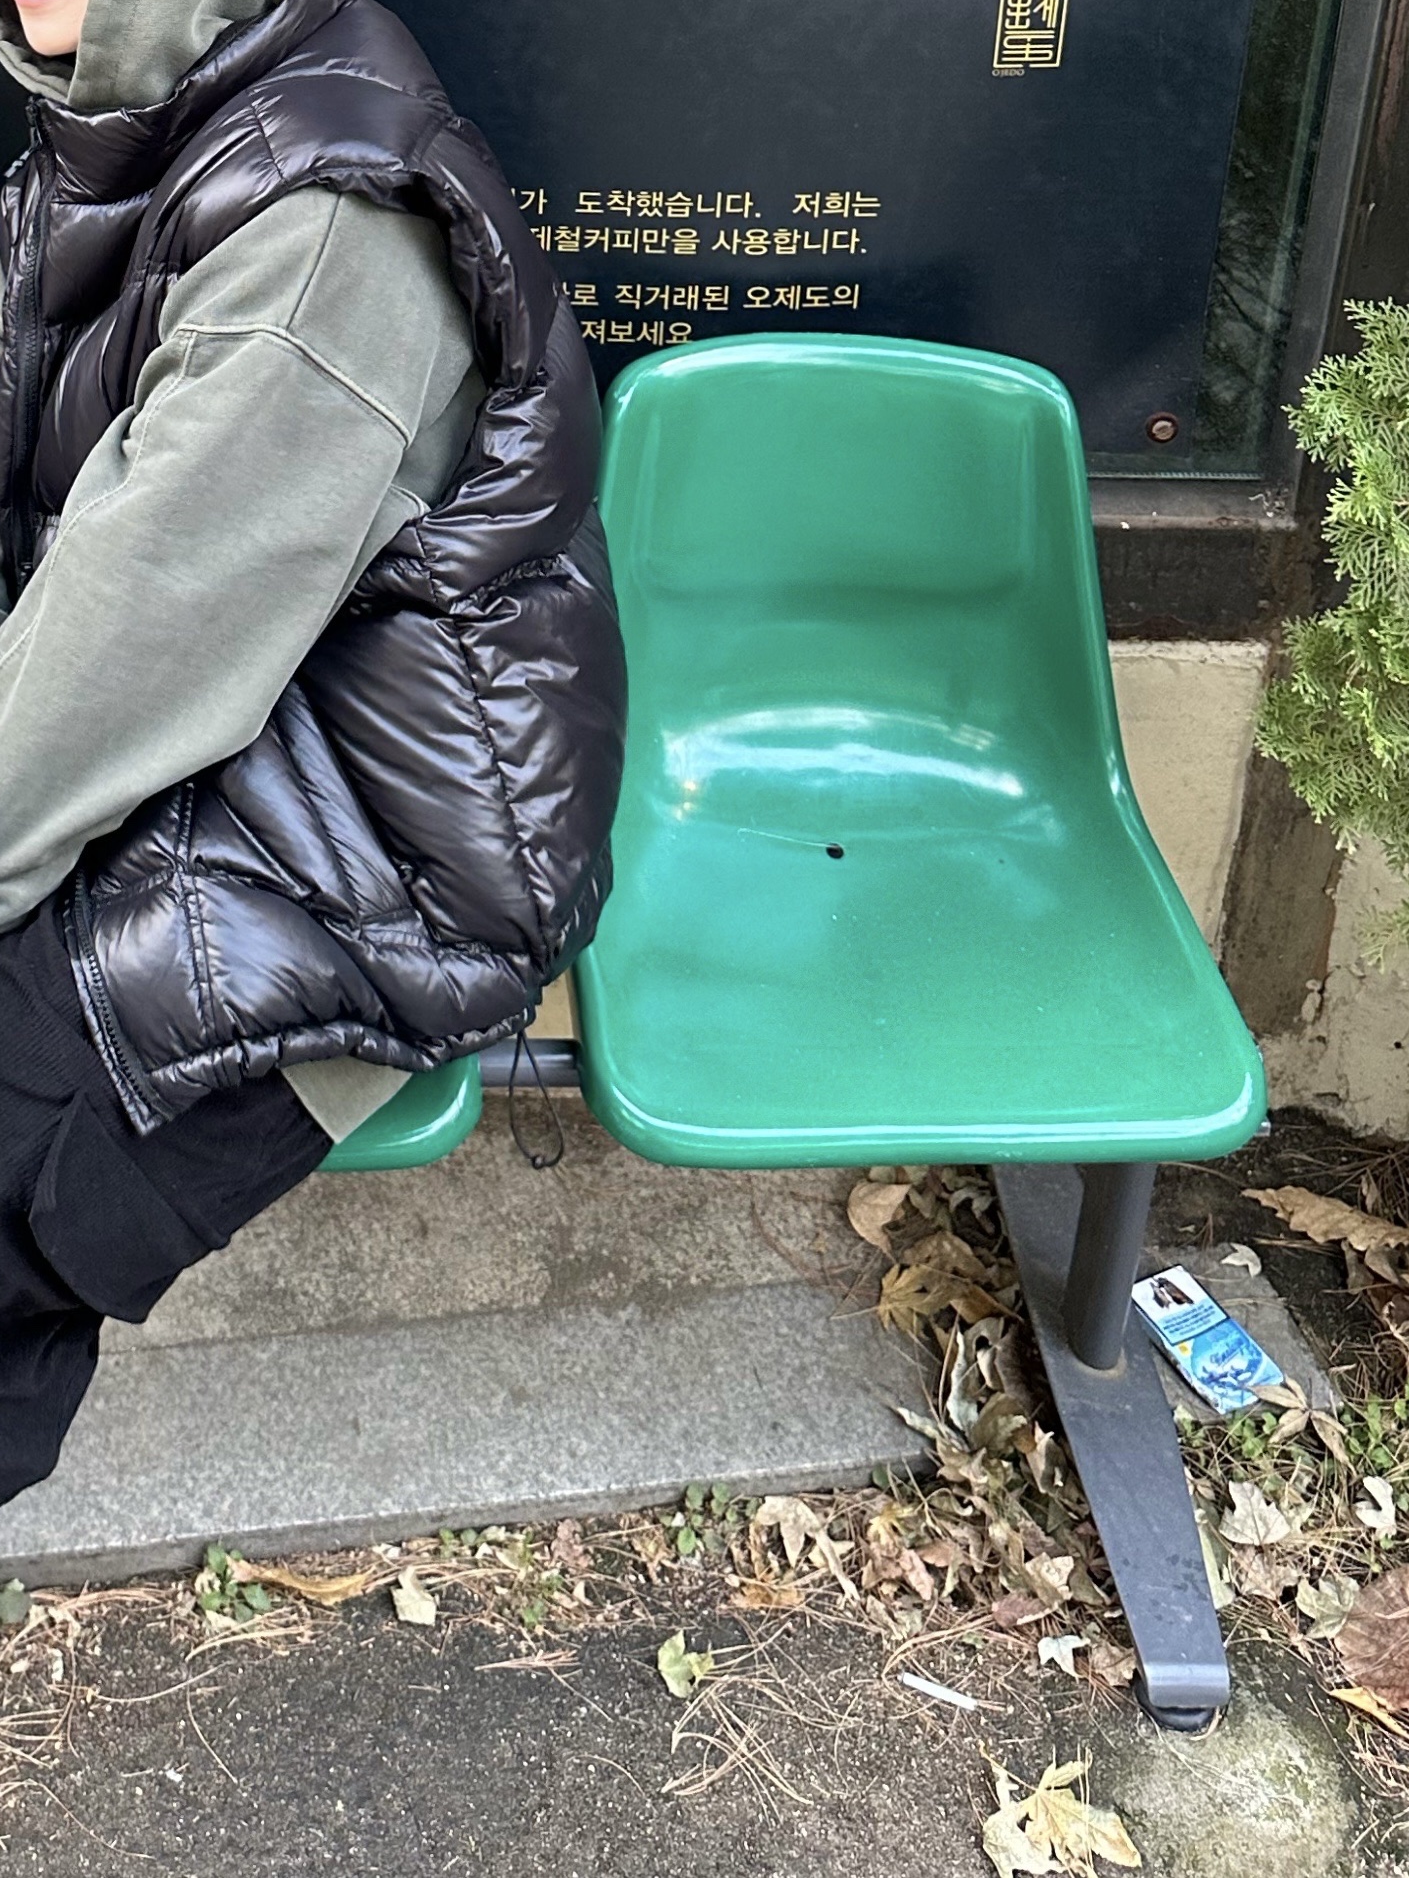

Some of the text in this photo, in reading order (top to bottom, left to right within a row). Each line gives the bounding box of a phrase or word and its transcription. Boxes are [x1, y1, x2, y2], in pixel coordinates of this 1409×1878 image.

[510, 187, 882, 219] 가 도착했습니다. 저희는
[711, 227, 868, 256] 사용합니다.
[614, 282, 730, 311] 직거래된
[742, 283, 860, 311] 오제도의
